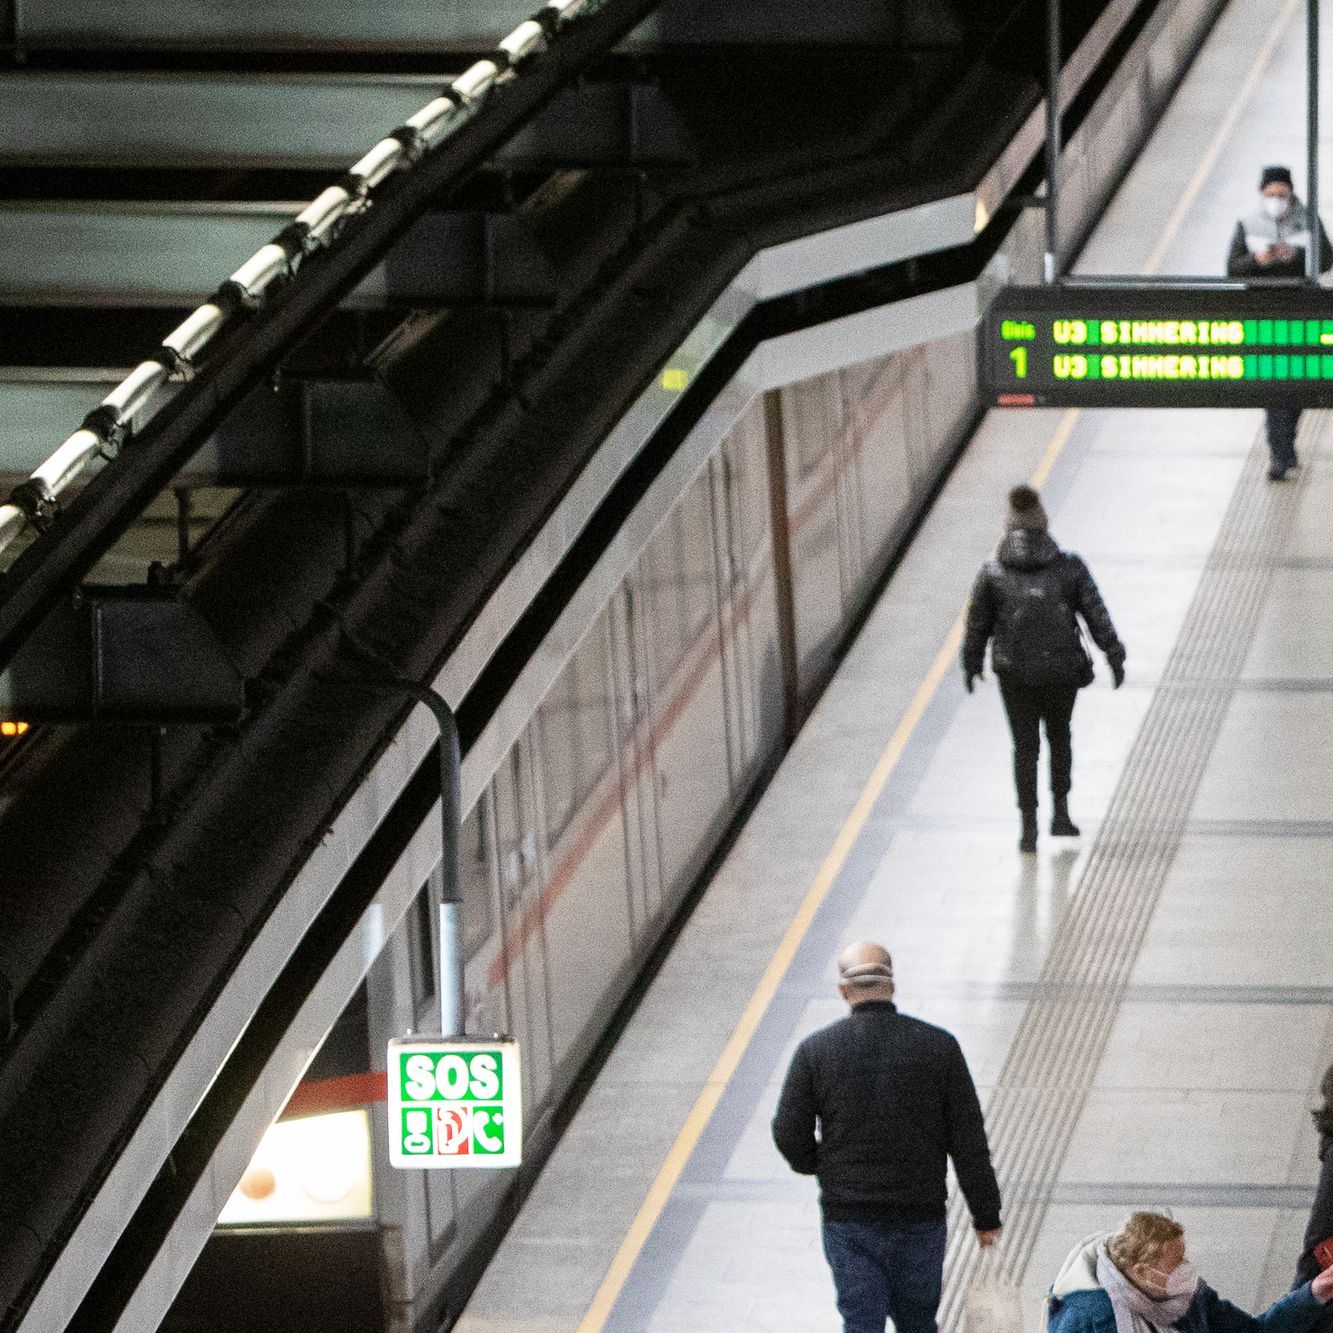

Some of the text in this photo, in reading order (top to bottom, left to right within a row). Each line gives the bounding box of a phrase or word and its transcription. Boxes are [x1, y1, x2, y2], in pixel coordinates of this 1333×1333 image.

[1053, 320, 1244, 344] U3 SIMMERING
[1009, 346, 1027, 378] 1
[1053, 356, 1087, 379] U3
[1100, 356, 1244, 379] SIMMERING
[405, 1054, 499, 1100] SOS
